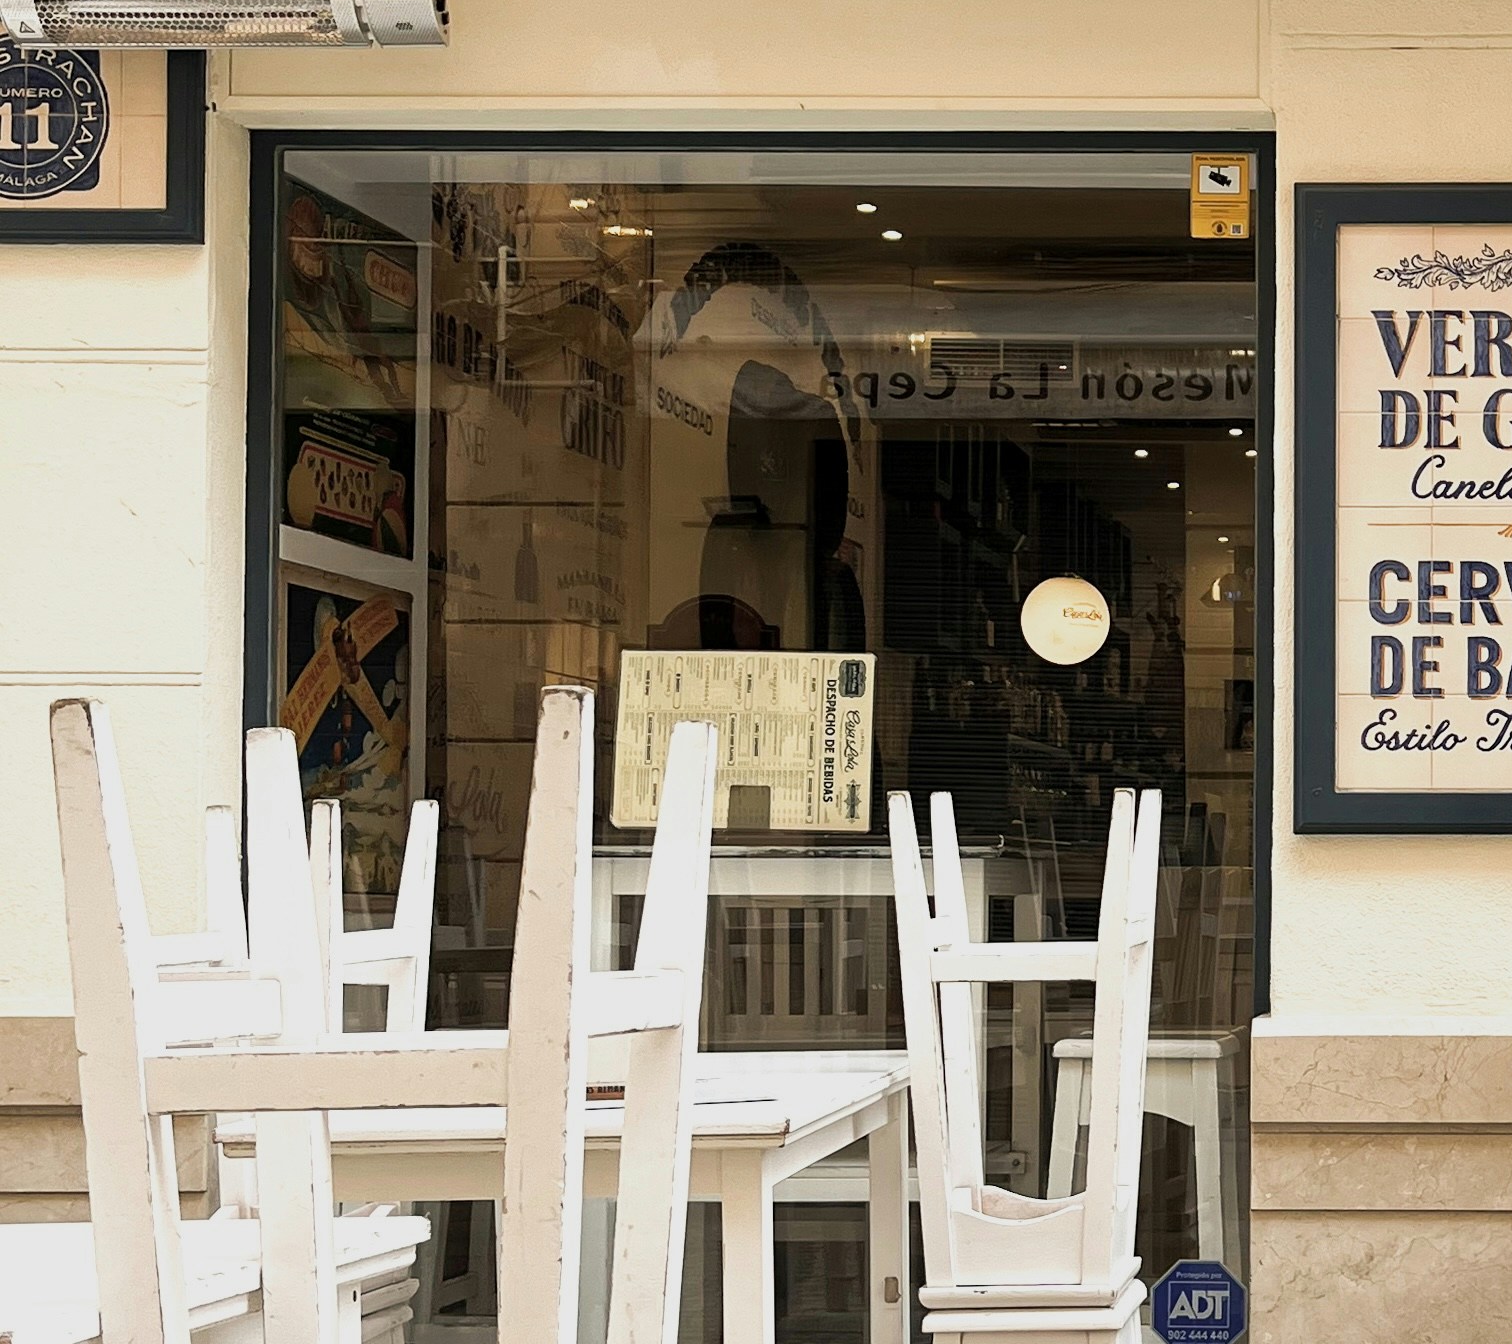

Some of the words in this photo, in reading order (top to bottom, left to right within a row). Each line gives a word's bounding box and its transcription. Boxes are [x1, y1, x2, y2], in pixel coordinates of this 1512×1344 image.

[0, 87, 63, 98] UMERO
[0, 102, 59, 149] 11
[657, 386, 713, 437] SOCIEDAD
[1378, 388, 1461, 452] DE
[1370, 635, 1441, 702] DE
[825, 679, 838, 736] DESPACHO
[846, 709, 860, 739] Casa
[824, 739, 836, 754] DE
[1360, 709, 1467, 754] Estilo
[844, 739, 860, 774] Lola
[823, 757, 835, 803] BEBIDAS
[1168, 1289, 1230, 1320] ADT
